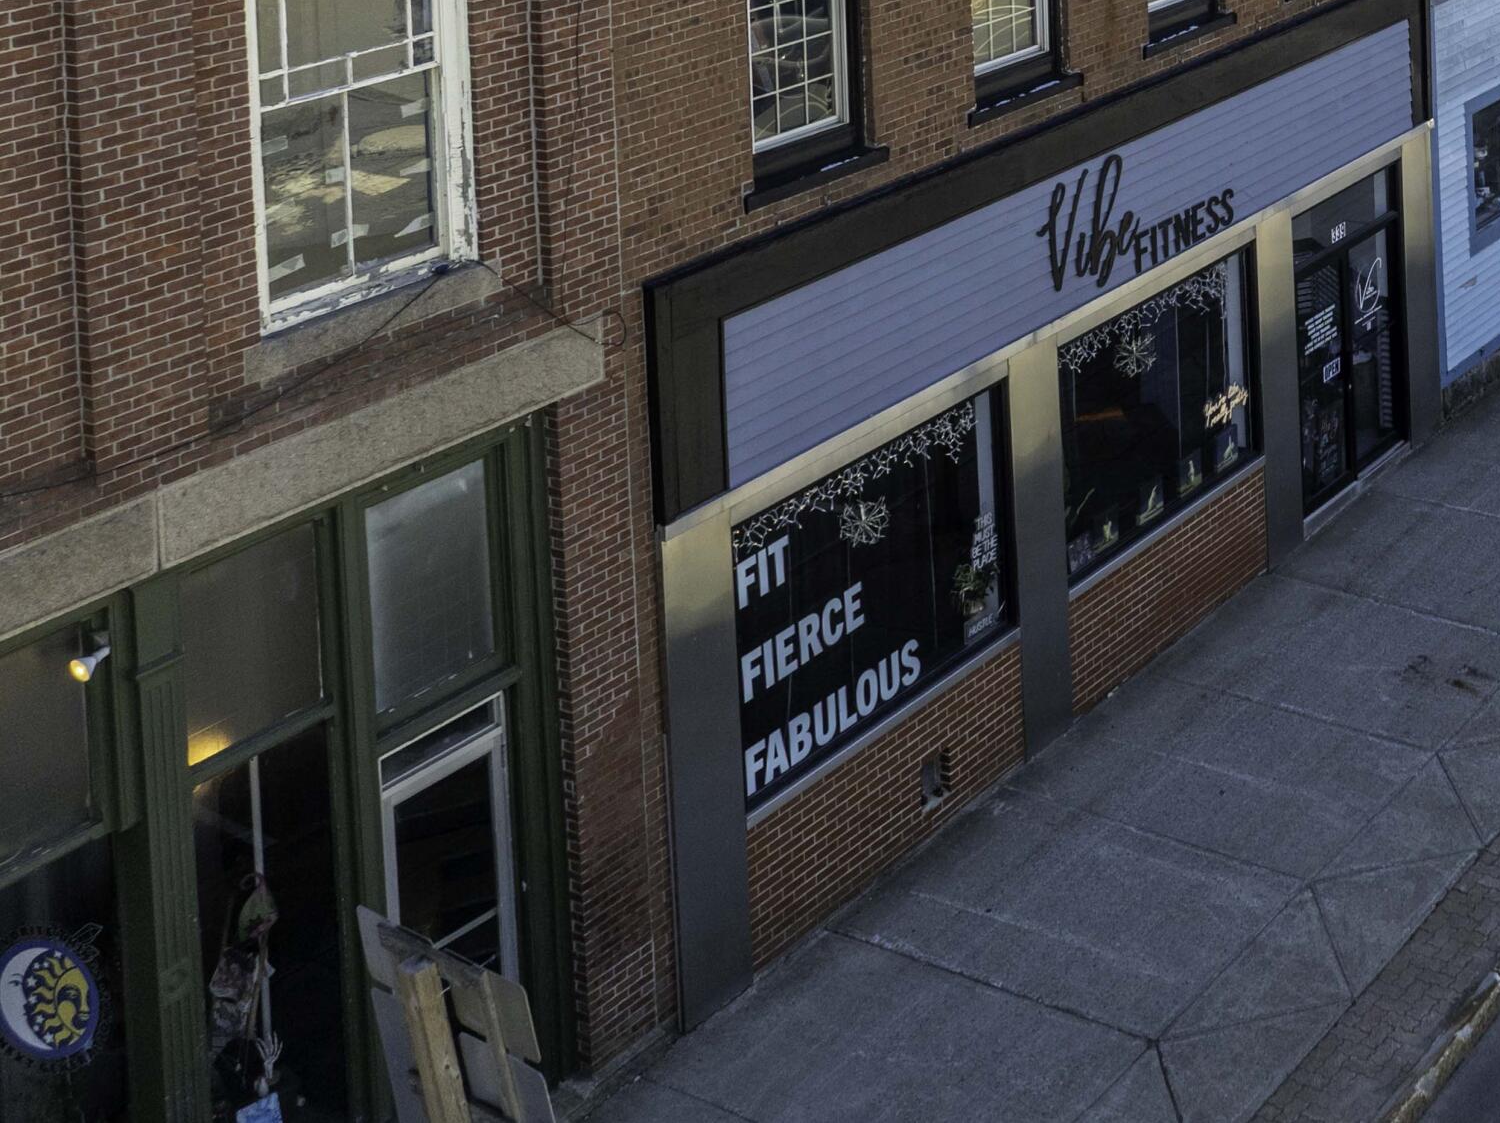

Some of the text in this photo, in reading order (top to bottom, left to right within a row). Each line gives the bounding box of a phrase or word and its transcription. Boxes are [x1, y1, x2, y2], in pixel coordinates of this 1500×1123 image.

[1036, 154, 1234, 292] Vibe FITNESS
[1324, 360, 1339, 379] OPEN
[973, 523, 995, 544] MUST
[974, 511, 993, 531] THIS
[972, 534, 998, 559] BE THE
[736, 534, 790, 610] FIT
[973, 548, 997, 571] PLACE
[740, 581, 866, 704] FIERCE
[744, 638, 921, 797] FABULOUS
